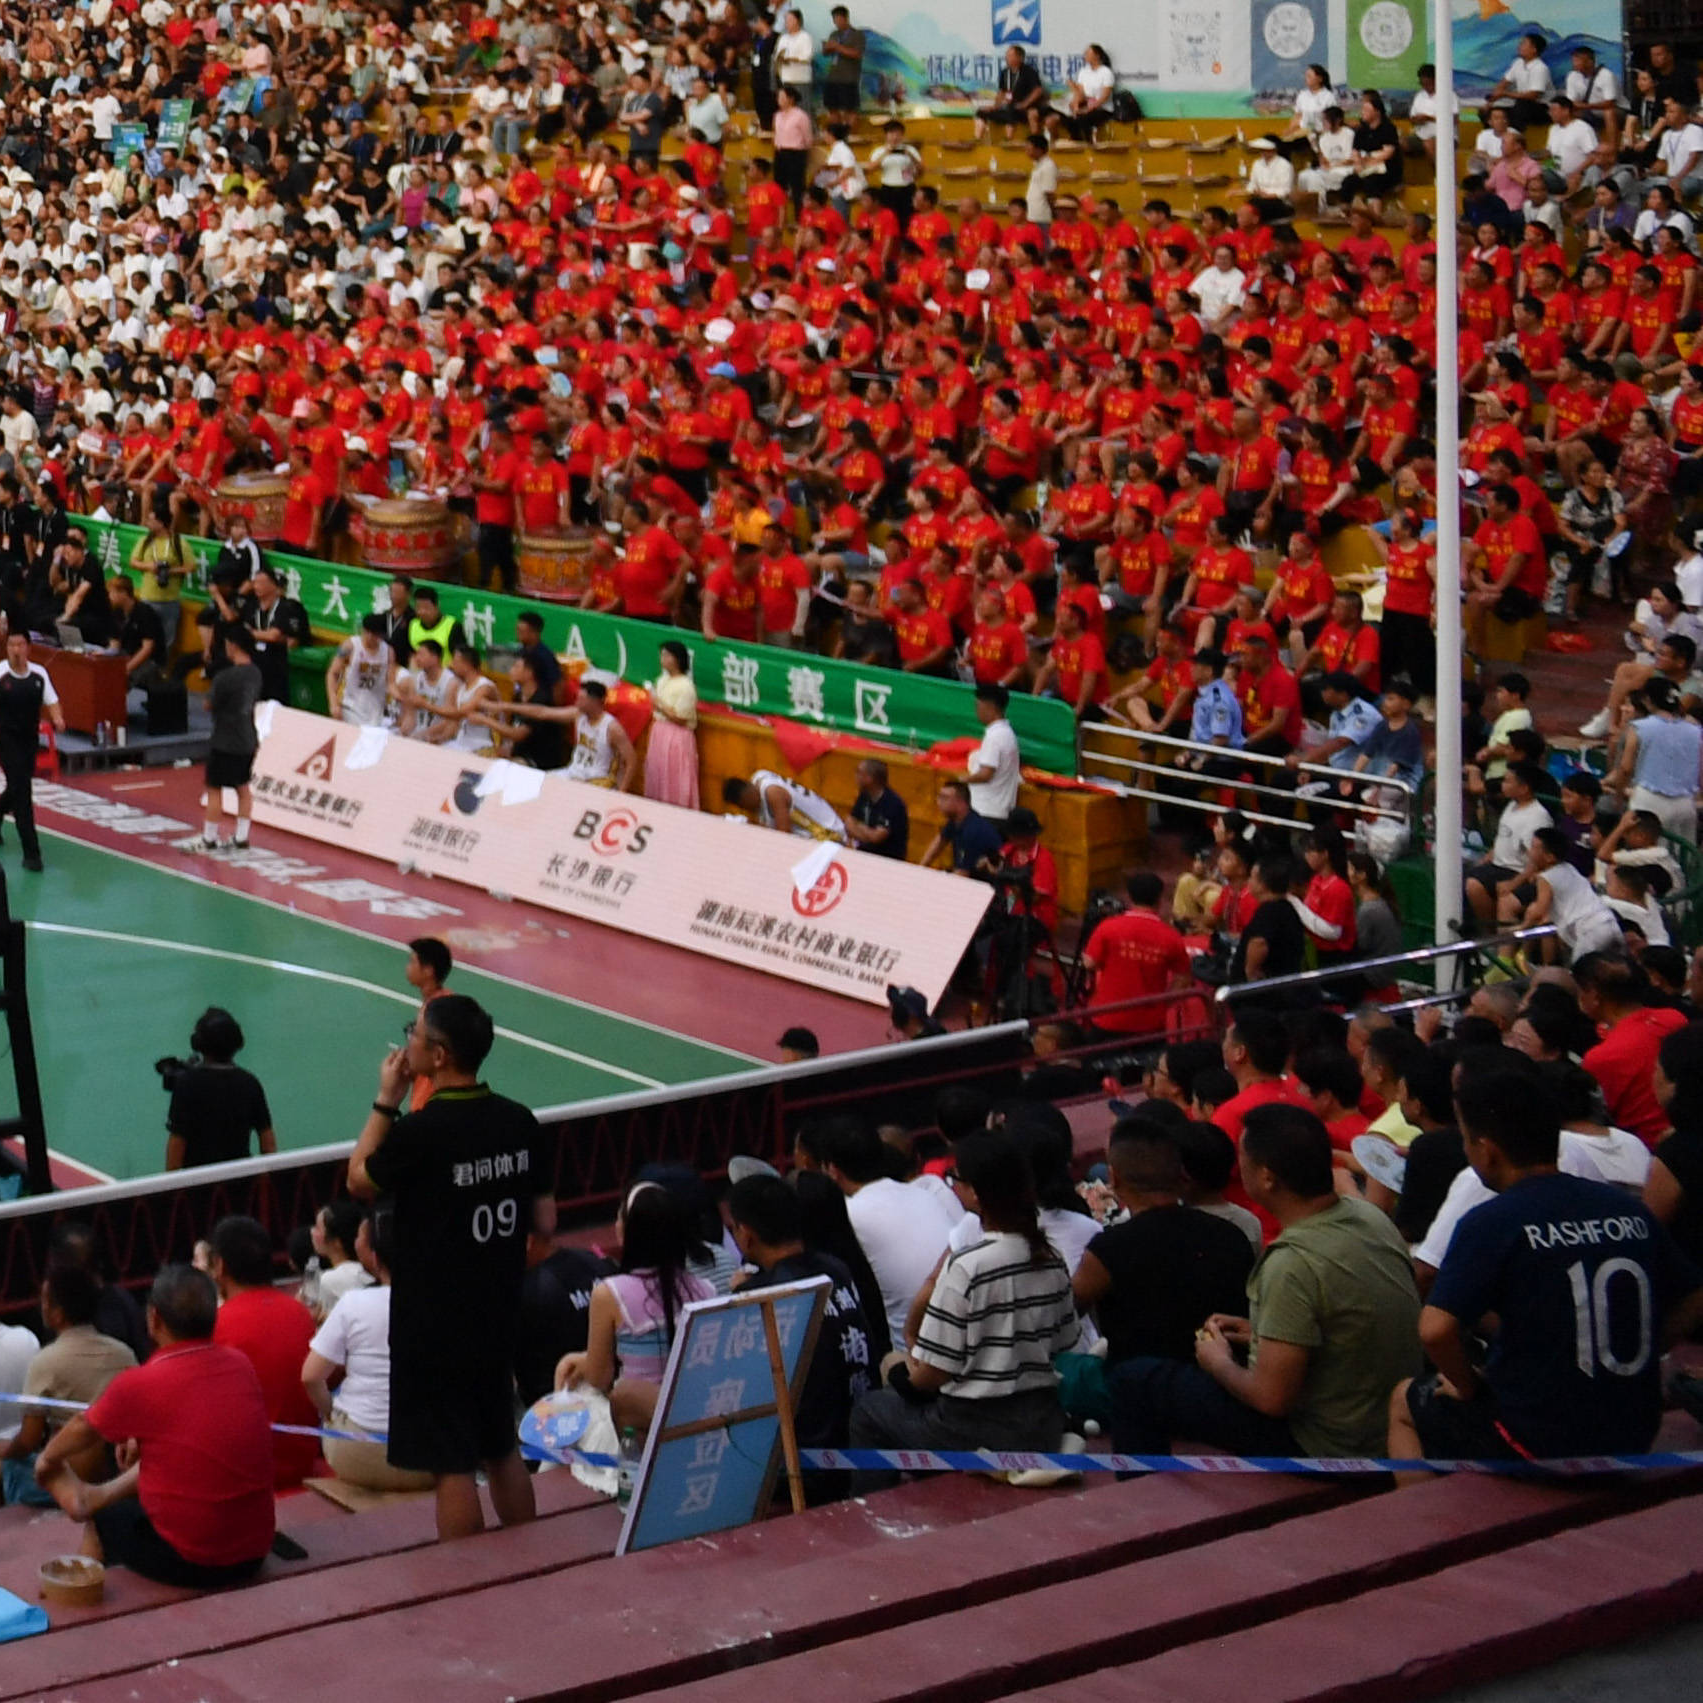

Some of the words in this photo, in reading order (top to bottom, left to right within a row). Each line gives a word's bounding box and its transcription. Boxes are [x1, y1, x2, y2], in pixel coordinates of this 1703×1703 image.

[409, 816, 482, 852] 湖南银行
[573, 809, 654, 854] BCS
[546, 852, 638, 896] 长沙银行
[695, 898, 902, 973] 湖南辰溪农村商业银行
[471, 1197, 518, 1244] 09
[1523, 1216, 1650, 1250] RASHFORD
[1567, 1257, 1652, 1378] 10
